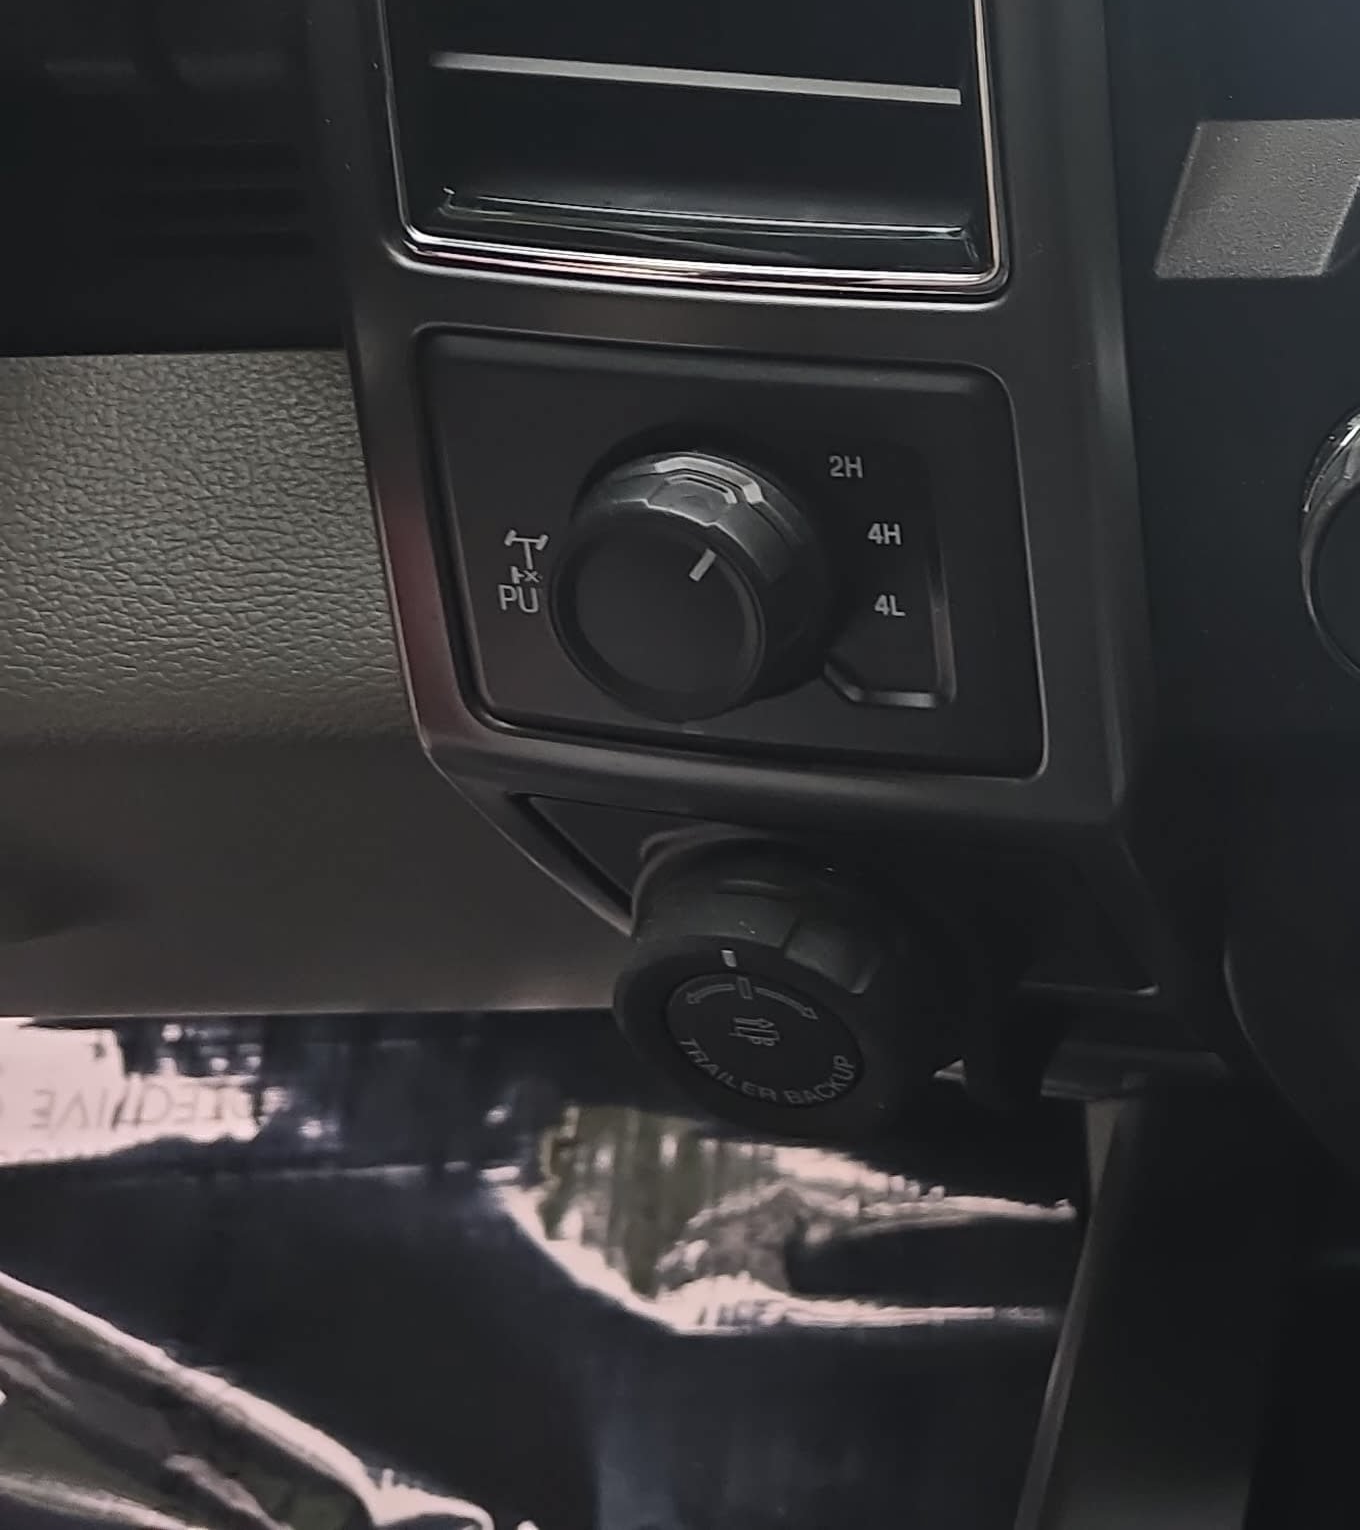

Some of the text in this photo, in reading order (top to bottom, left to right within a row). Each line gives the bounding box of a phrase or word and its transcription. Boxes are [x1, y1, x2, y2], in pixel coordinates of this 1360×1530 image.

[828, 454, 864, 479] 2H
[867, 522, 902, 546] 4H
[874, 594, 905, 617] 4L
[679, 1037, 856, 1105] TRAILER BACKUP
